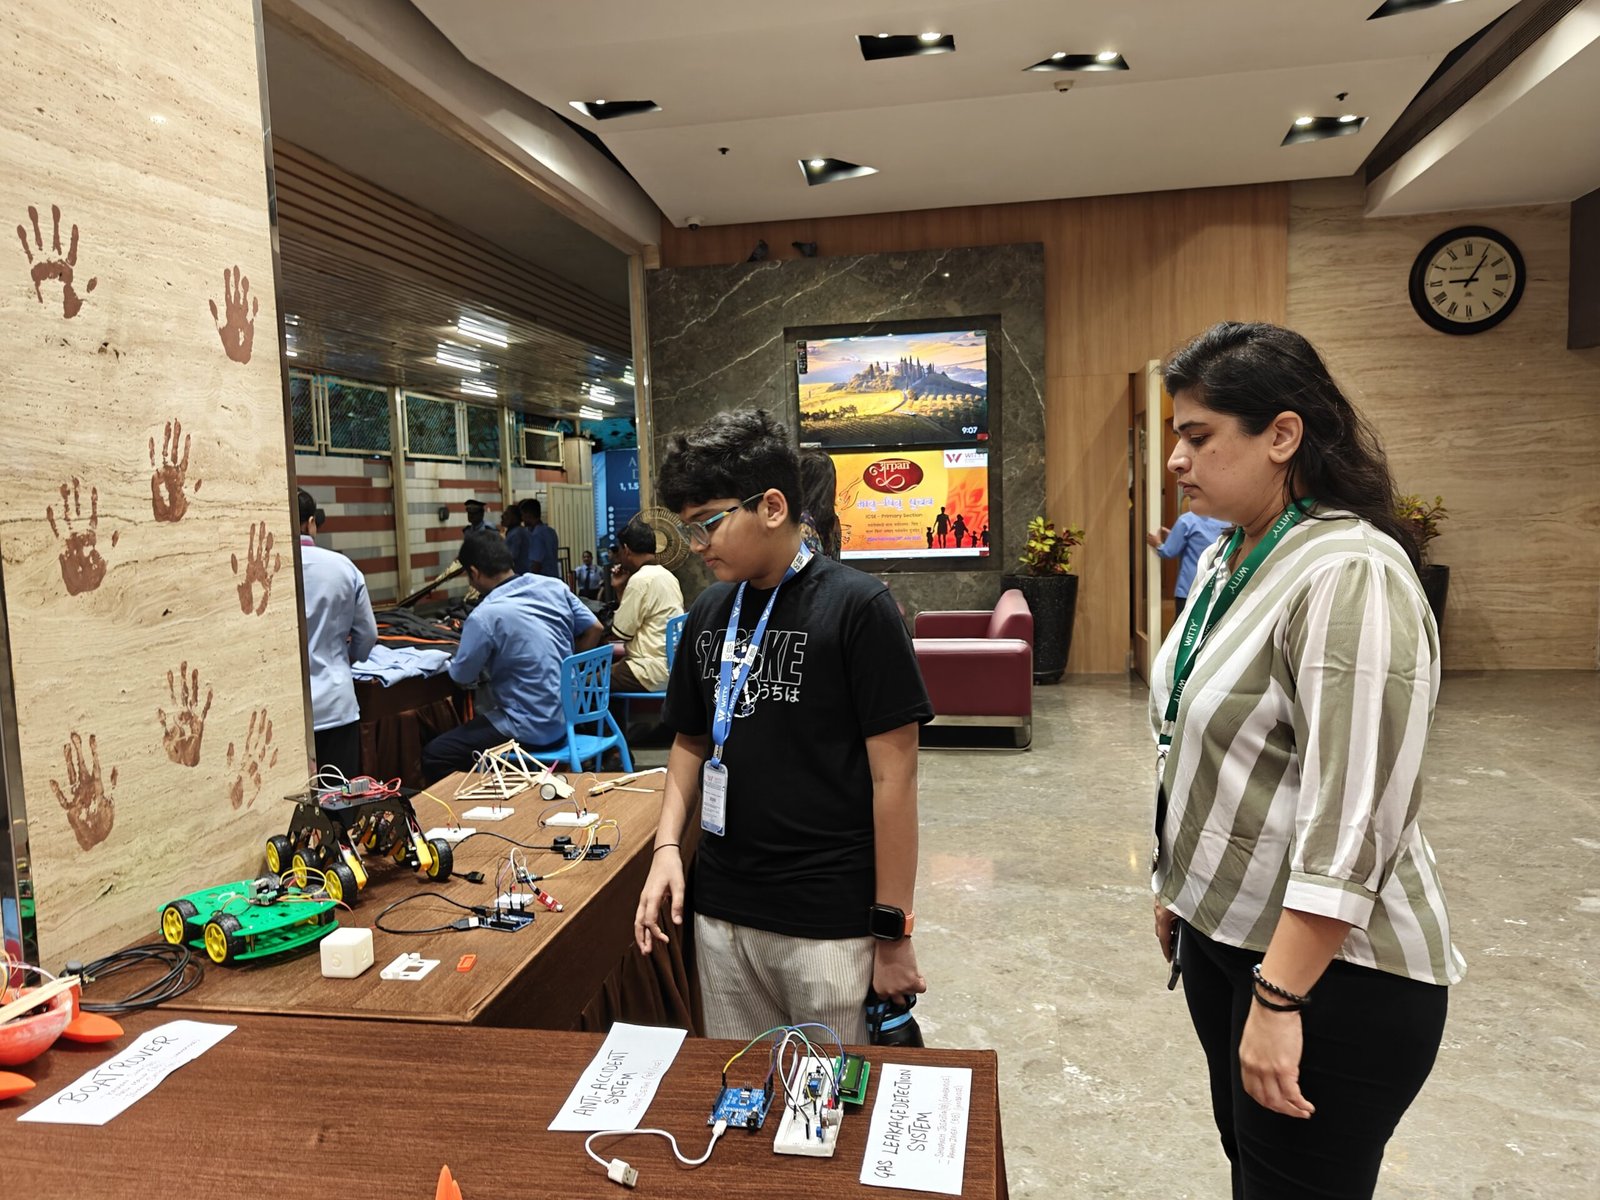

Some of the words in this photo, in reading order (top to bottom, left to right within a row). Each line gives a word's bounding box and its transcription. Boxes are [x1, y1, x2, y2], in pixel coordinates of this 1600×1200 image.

[961, 426, 978, 435] 9:07
[1272, 511, 1295, 537] WITTY
[1229, 566, 1249, 593] WITTY
[1183, 620, 1199, 647] WITTY
[760, 684, 800, 703] うちは
[58, 1070, 124, 1104] BOAT
[109, 1035, 178, 1071] ROVER
[604, 1072, 638, 1104] SYSTEM
[892, 1069, 912, 1109] DETECTION
[882, 1109, 909, 1155] LEAKAGE
[907, 1112, 932, 1151] SYSTEM
[874, 1160, 896, 1178] GAS
